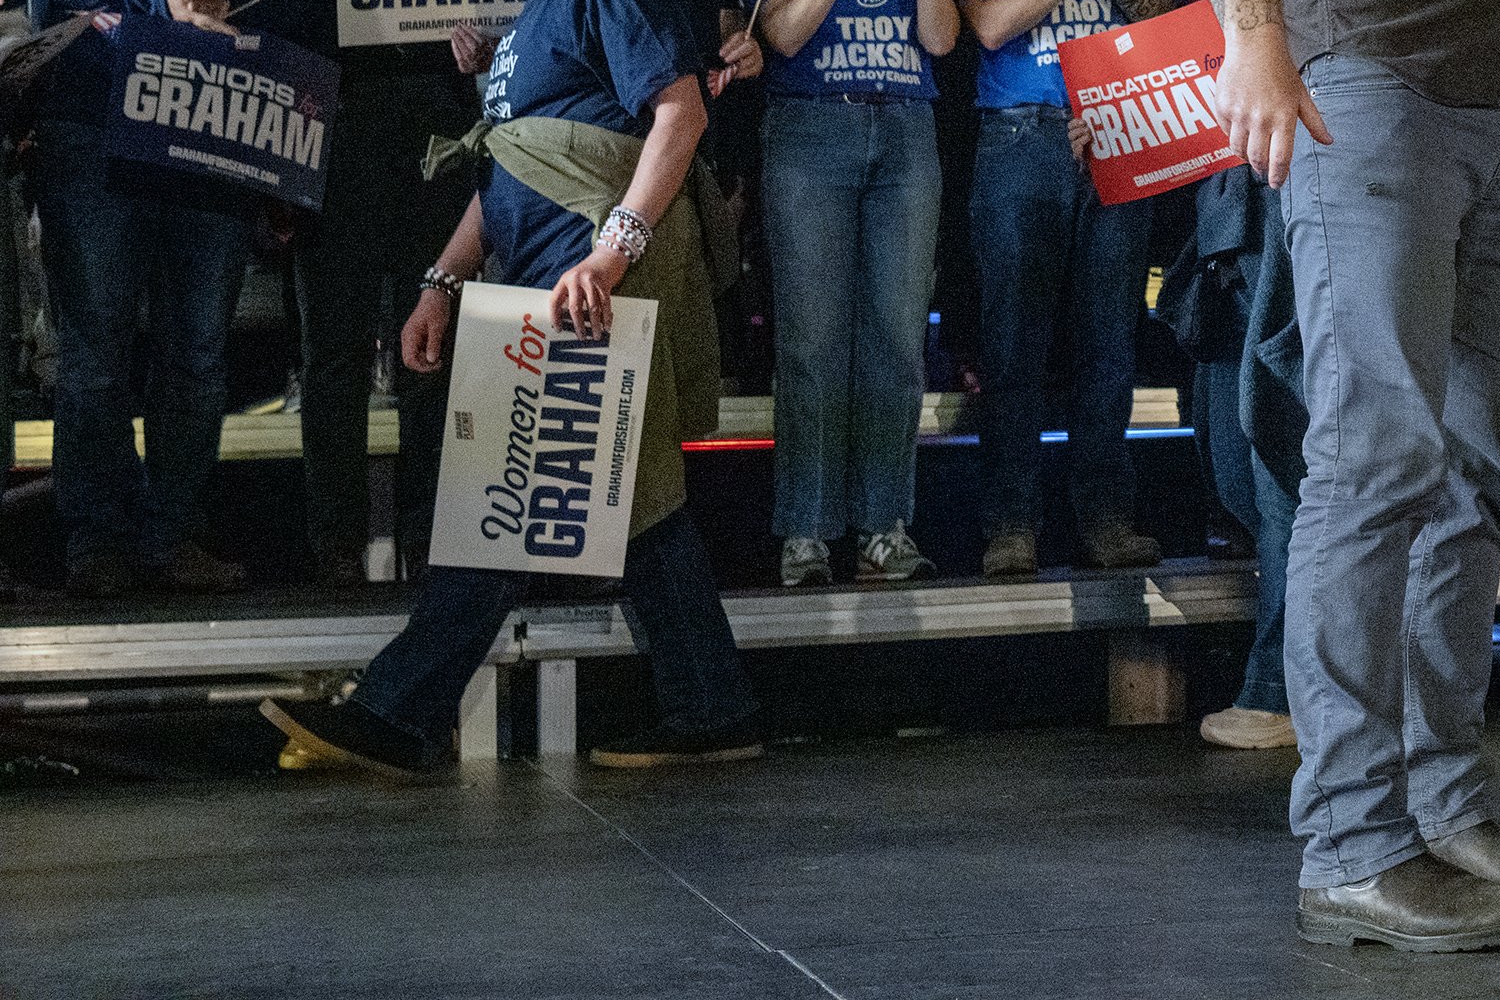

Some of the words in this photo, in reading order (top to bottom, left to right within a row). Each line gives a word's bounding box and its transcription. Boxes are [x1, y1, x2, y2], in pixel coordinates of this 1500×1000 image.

[836, 15, 911, 41] TROY
[135, 52, 295, 107] SENIORS
[824, 71, 853, 83] FOR
[856, 69, 921, 85] GOVERNOR
[1076, 59, 1201, 106] EDUCATORS
[1203, 53, 1225, 72] for
[123, 71, 325, 170] GRAHAM
[504, 313, 546, 376] for
[481, 385, 539, 540] Women
[606, 369, 636, 507] GRAHAMFORSENATE.COM
